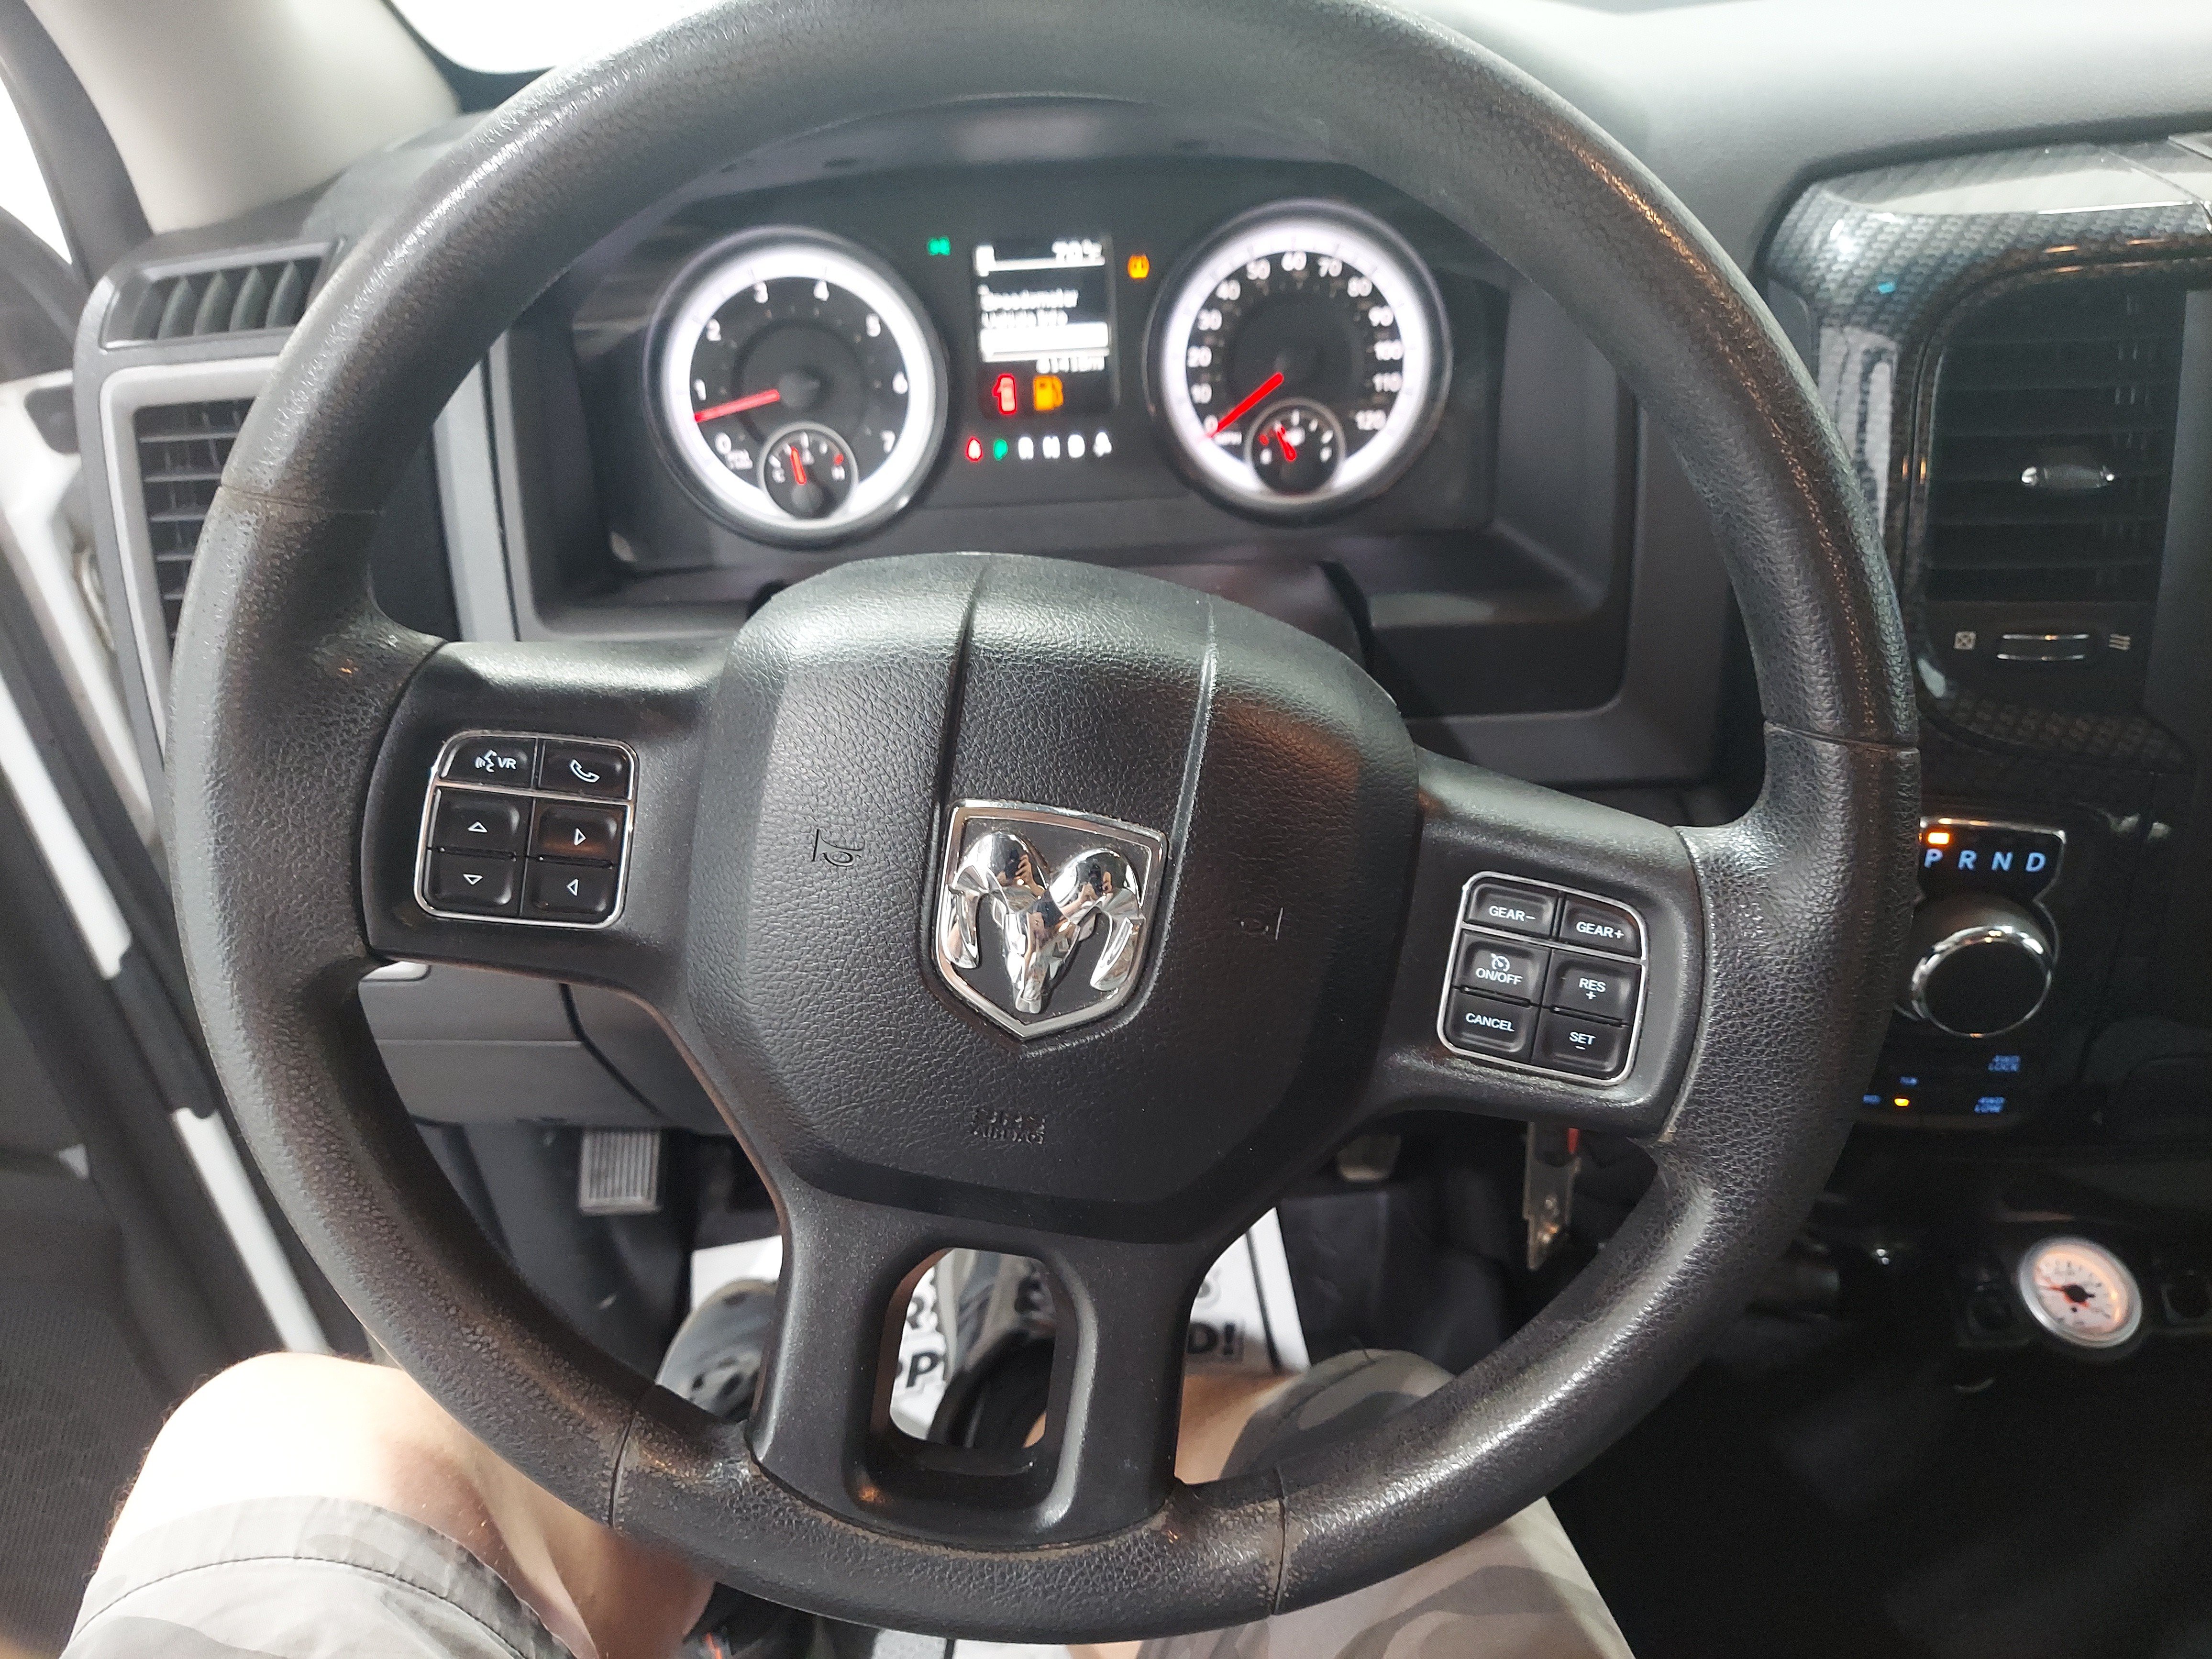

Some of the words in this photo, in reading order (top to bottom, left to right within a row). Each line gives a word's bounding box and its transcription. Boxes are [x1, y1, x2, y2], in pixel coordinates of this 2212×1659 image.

[1318, 257, 1342, 277] 70
[497, 757, 516, 770] VR
[1924, 848, 1943, 868] P
[1958, 850, 1977, 870] R
[1991, 851, 2013, 872] N
[2025, 852, 2046, 872] D
[1576, 921, 1624, 940] GEAR+
[1476, 967, 1523, 985] ON/OFF
[1579, 978, 1606, 993] RES
[1465, 1012, 1515, 1032] CANCEL
[1569, 1031, 1596, 1046] SET
